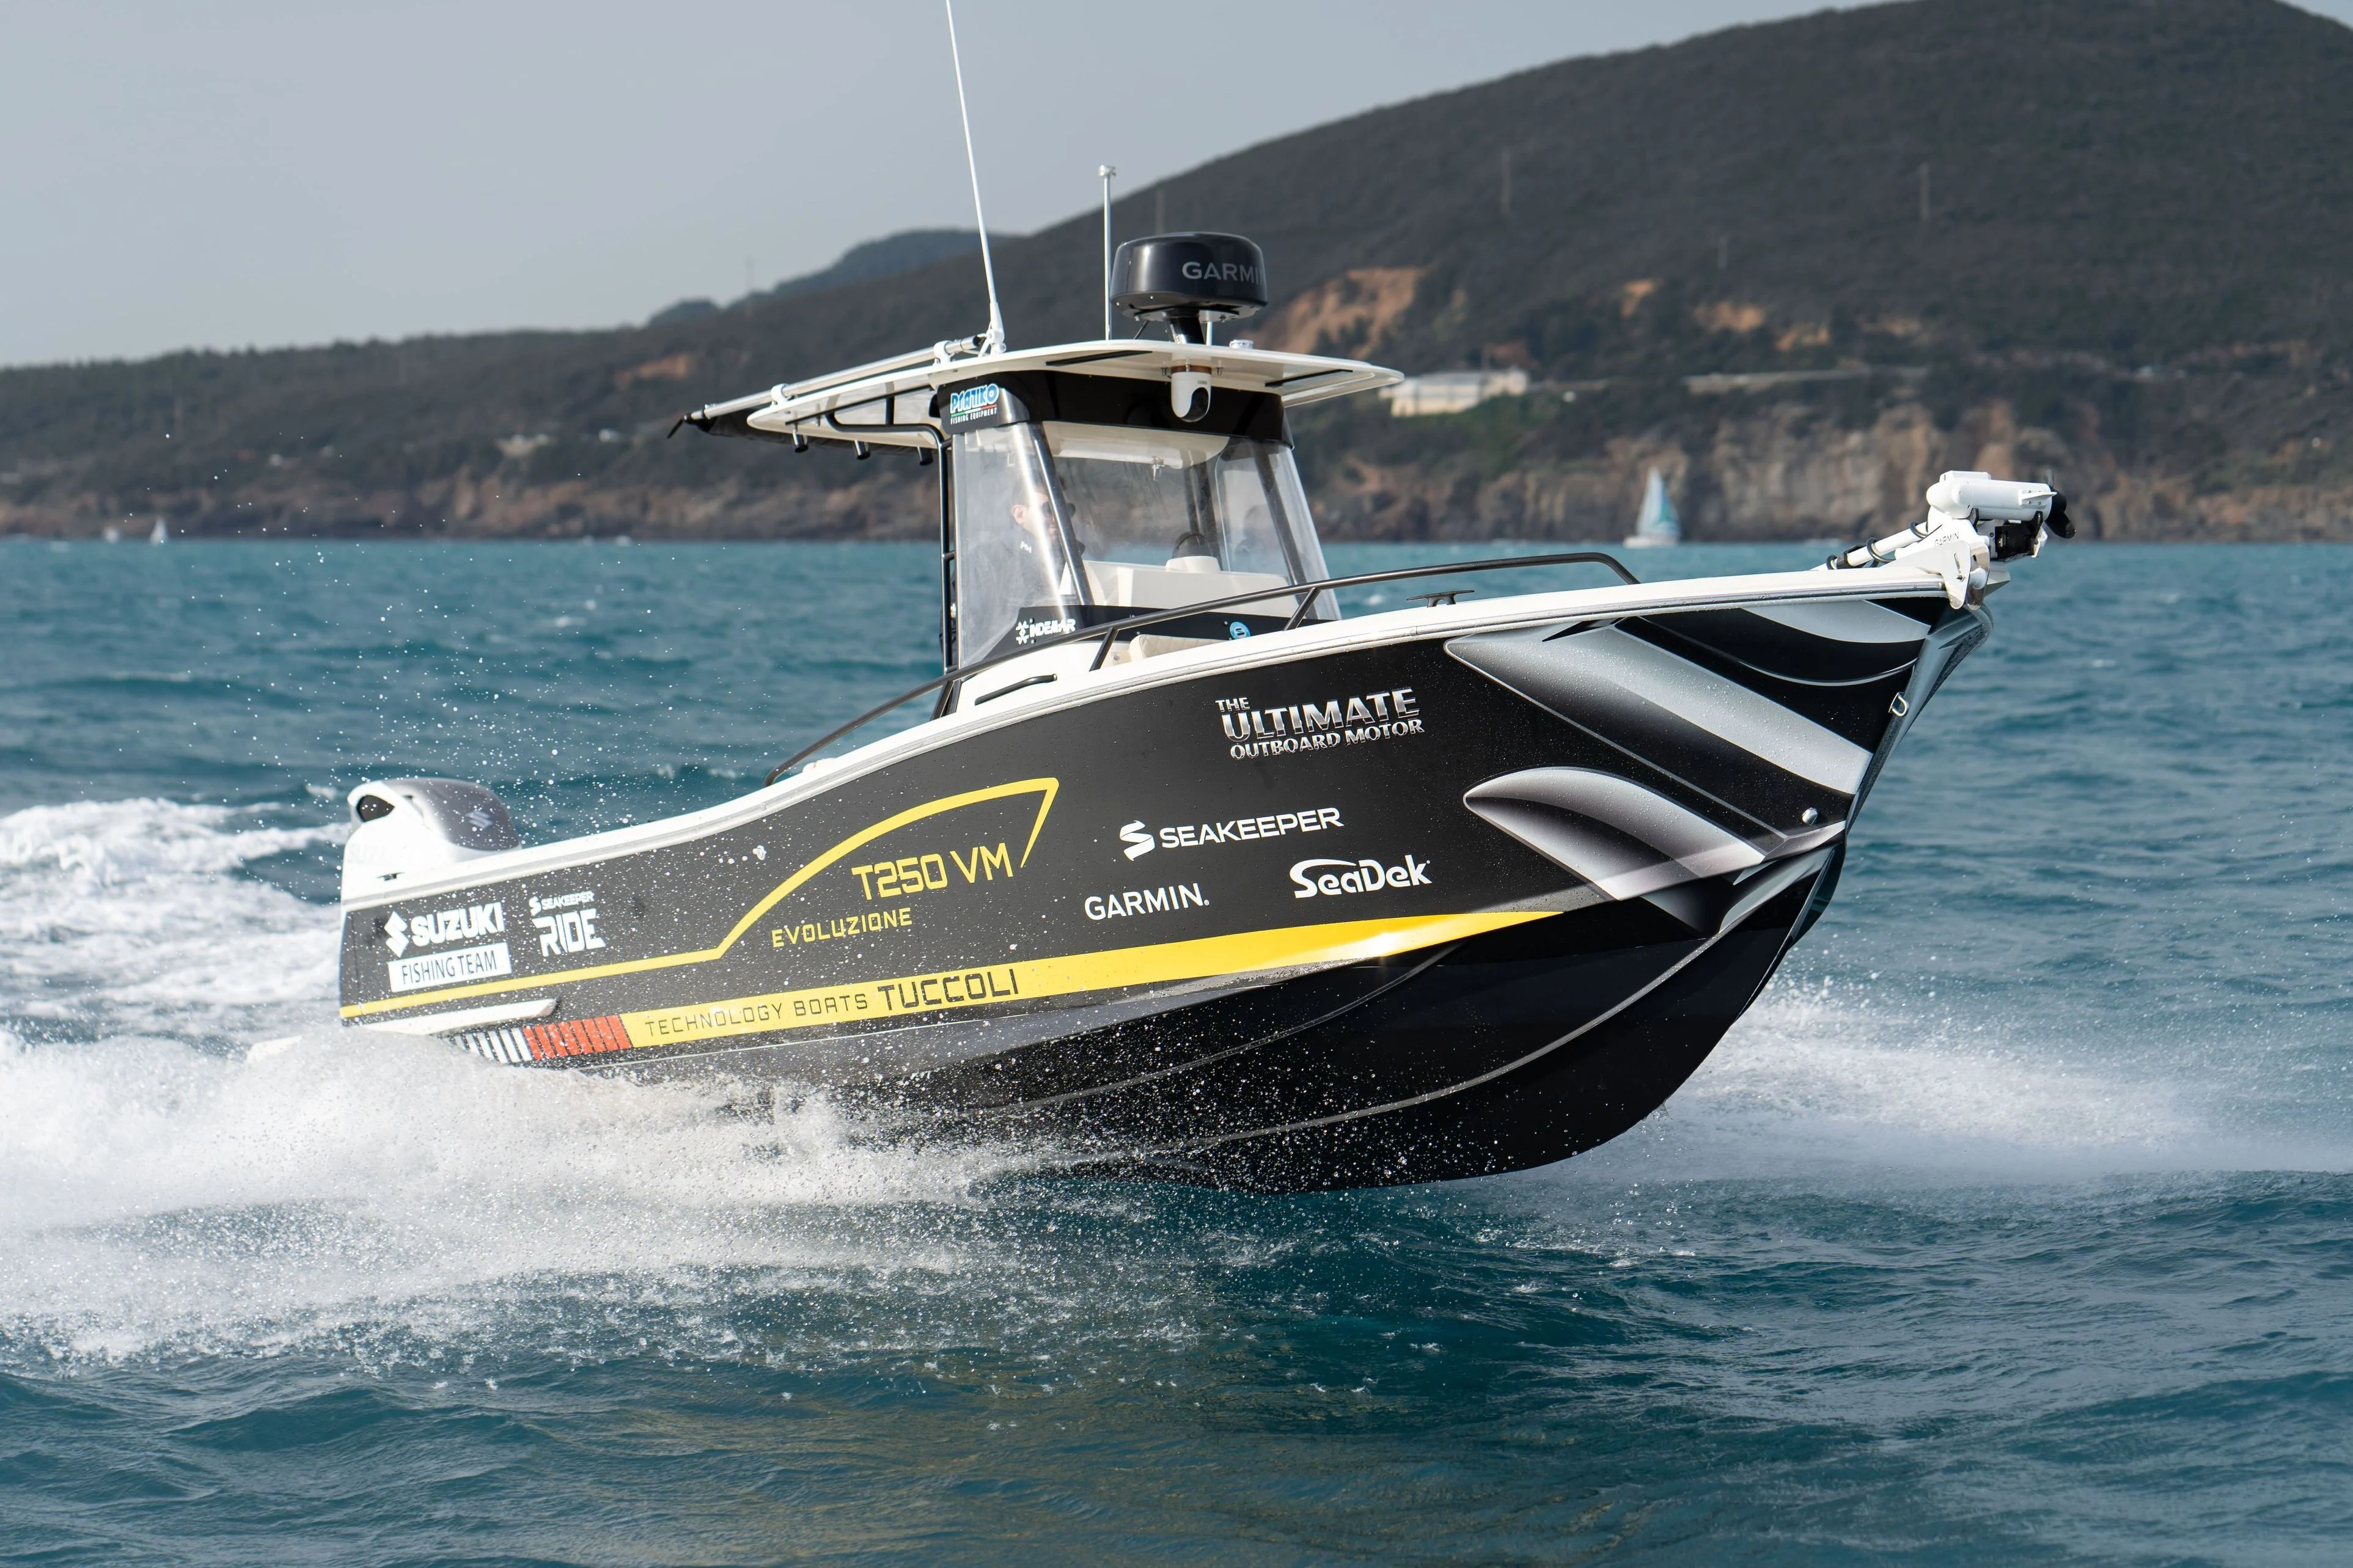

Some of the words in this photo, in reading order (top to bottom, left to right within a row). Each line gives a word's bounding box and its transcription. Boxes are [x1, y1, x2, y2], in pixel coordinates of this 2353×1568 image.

[951, 414, 968, 425] FISHING
[971, 408, 997, 420] EQUIPMENT
[1215, 697, 1250, 713] THE
[1222, 686, 1420, 742] ULTIMATE
[1230, 732, 1341, 760] OUTBOARD
[1345, 719, 1425, 747] MOTOR
[1159, 807, 1345, 849] SEAKEEPER
[851, 853, 948, 900] T250
[950, 843, 1013, 884] VM
[541, 890, 595, 910] SEAKEEPER
[411, 902, 505, 947] SUZUKI
[532, 909, 606, 957] RIDE
[771, 907, 912, 948] EVOLUZIONE
[402, 957, 456, 986] FISHING
[459, 950, 497, 978] TEAM
[645, 1002, 783, 1037] TECHNOLOGY
[793, 993, 868, 1017] BOATS
[878, 969, 1019, 1011] TUCCOLI
